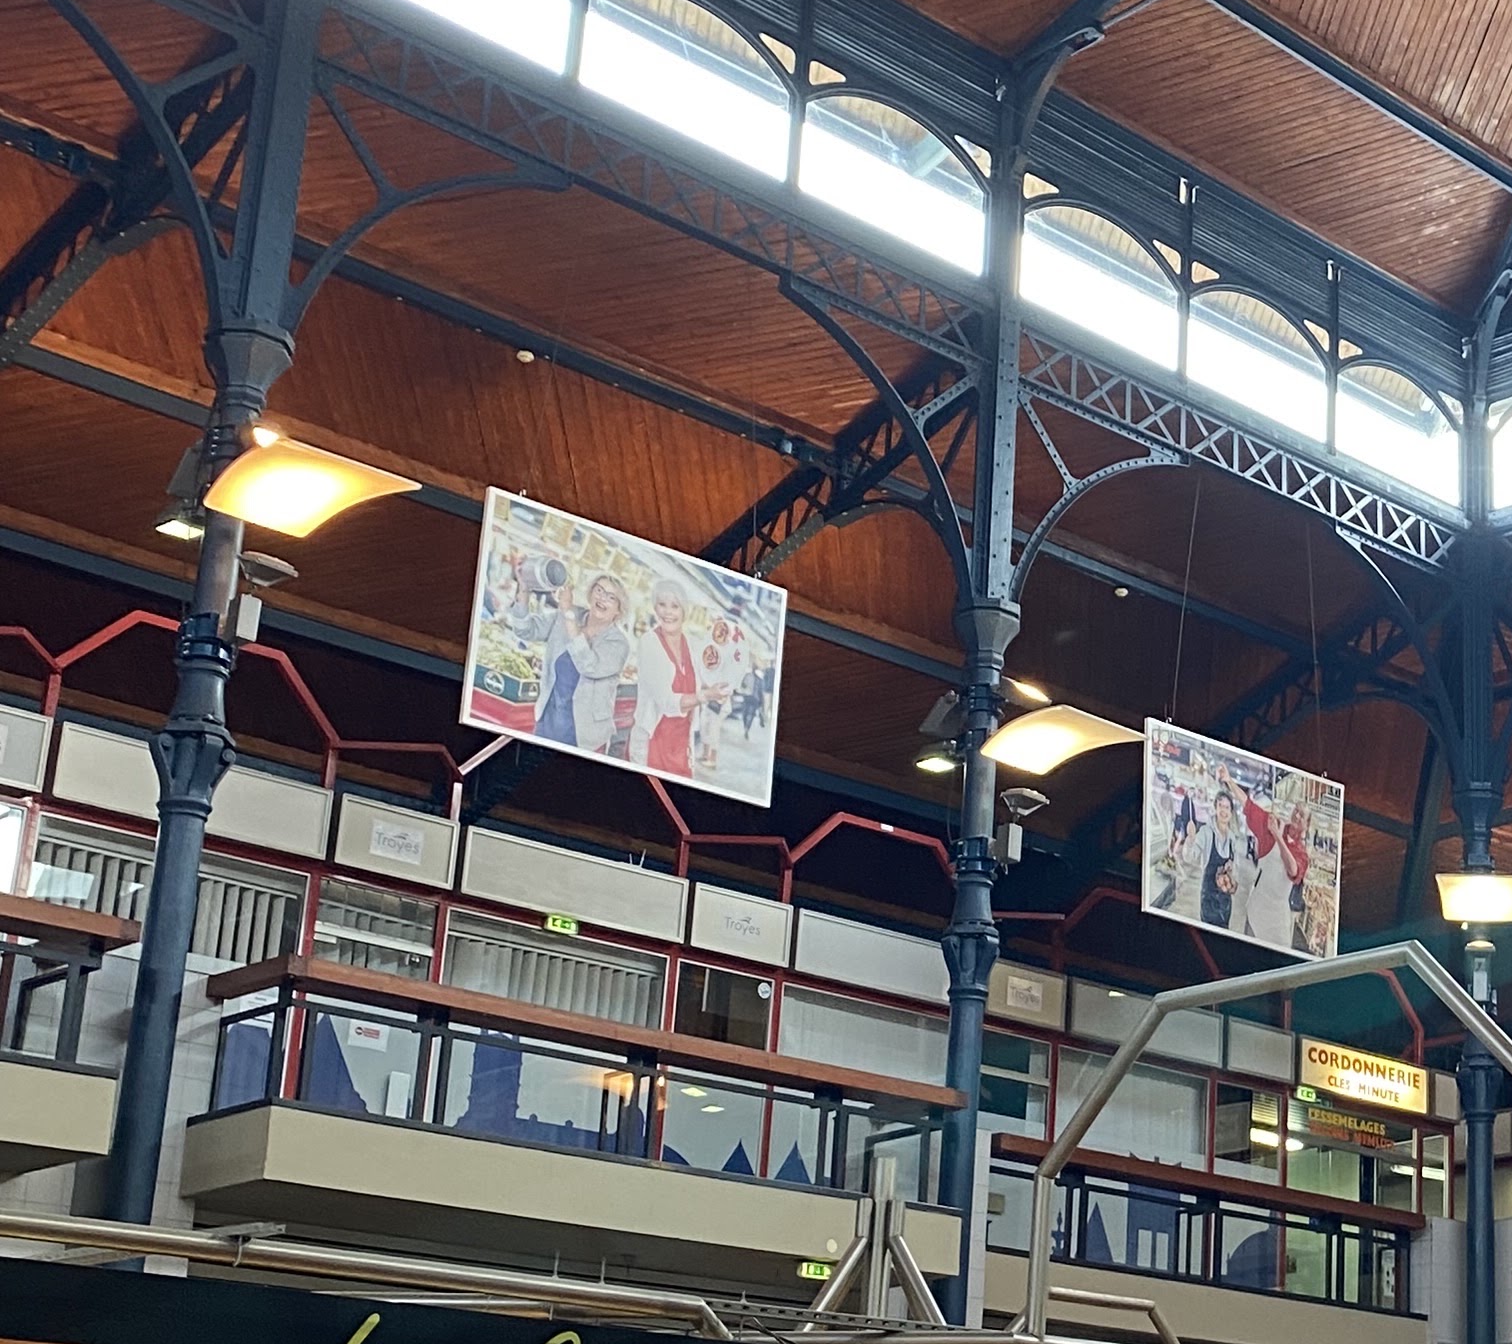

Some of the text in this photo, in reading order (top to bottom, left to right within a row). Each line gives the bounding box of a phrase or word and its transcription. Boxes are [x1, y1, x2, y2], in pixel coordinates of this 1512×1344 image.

[375, 831, 420, 855] Troyes
[724, 917, 761, 936] Troyes
[1307, 1046, 1421, 1090] CORDONNERIE
[1358, 1084, 1400, 1103] MINUTE
